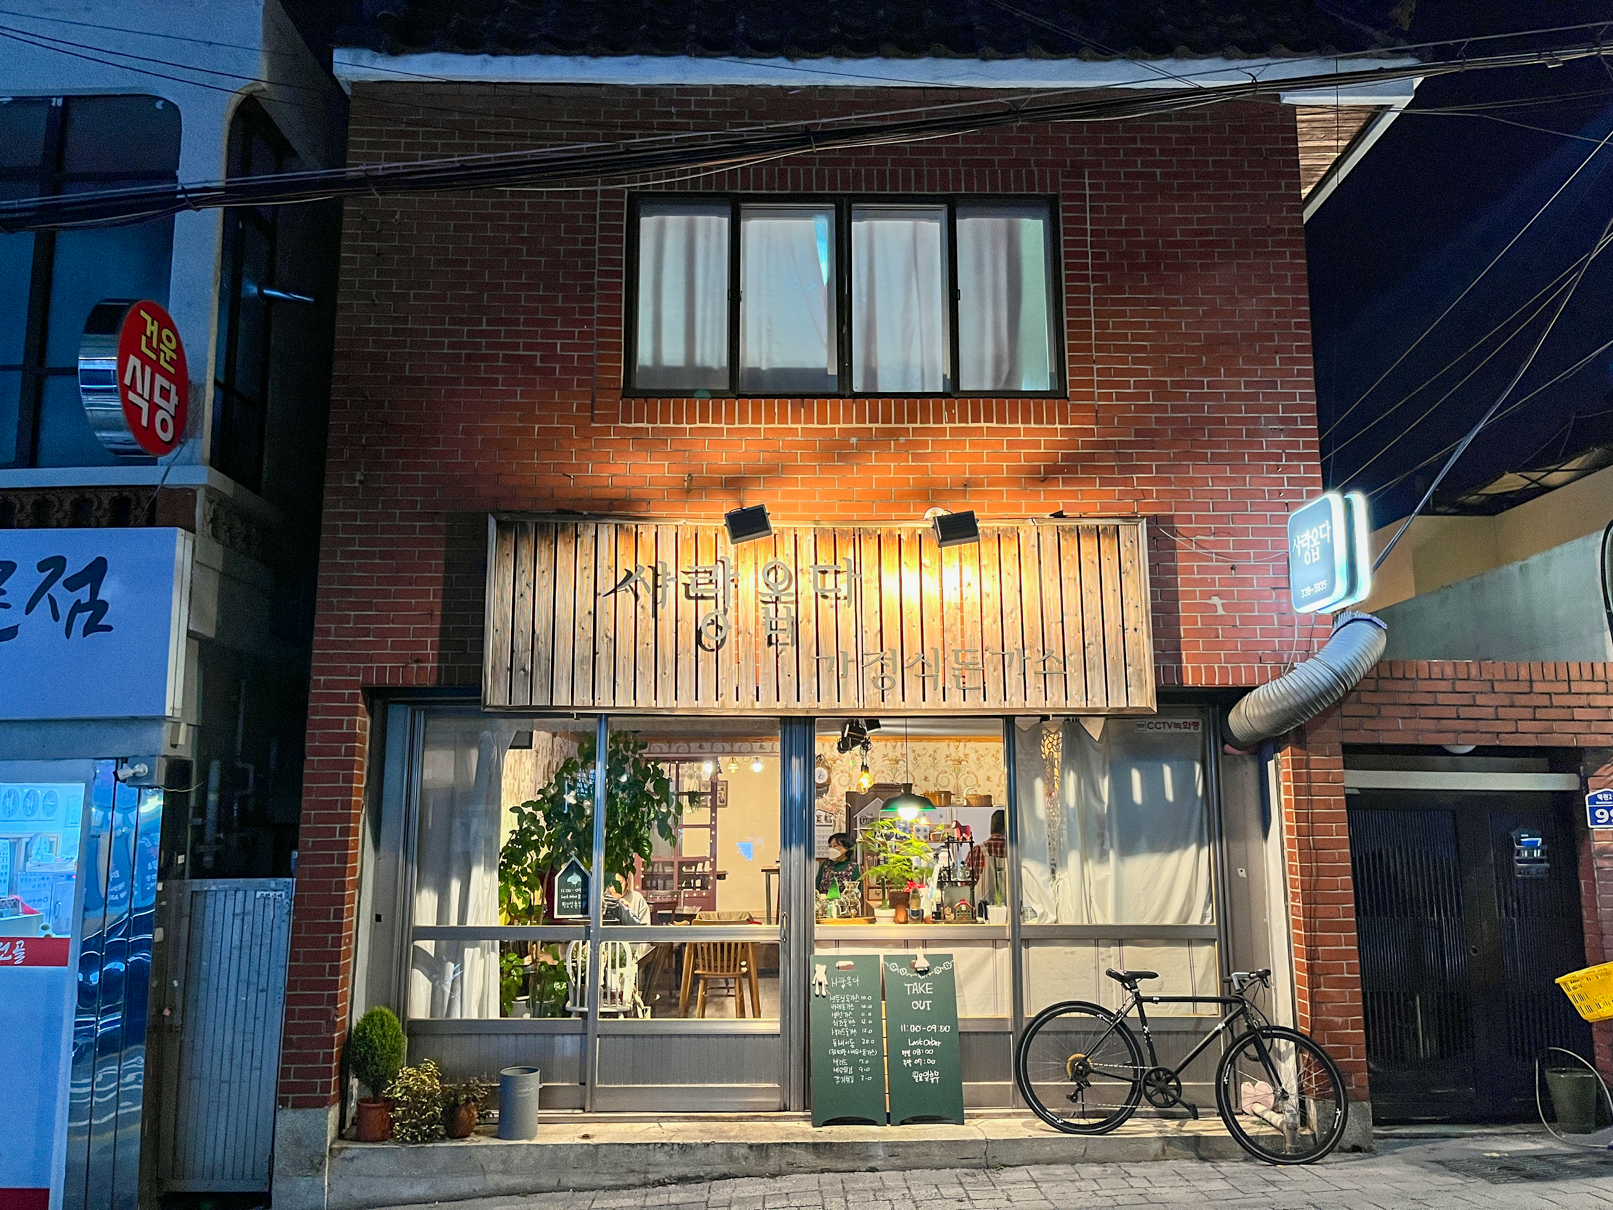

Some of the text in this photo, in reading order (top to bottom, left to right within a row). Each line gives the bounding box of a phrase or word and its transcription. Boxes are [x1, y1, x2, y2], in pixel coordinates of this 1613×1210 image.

[124, 353, 179, 443] 식당
[612, 555, 862, 641] 사랑옵다
[1595, 808, 1613, 823] 9
[904, 982, 933, 995] TAKE
[911, 1000, 932, 1010] OUT
